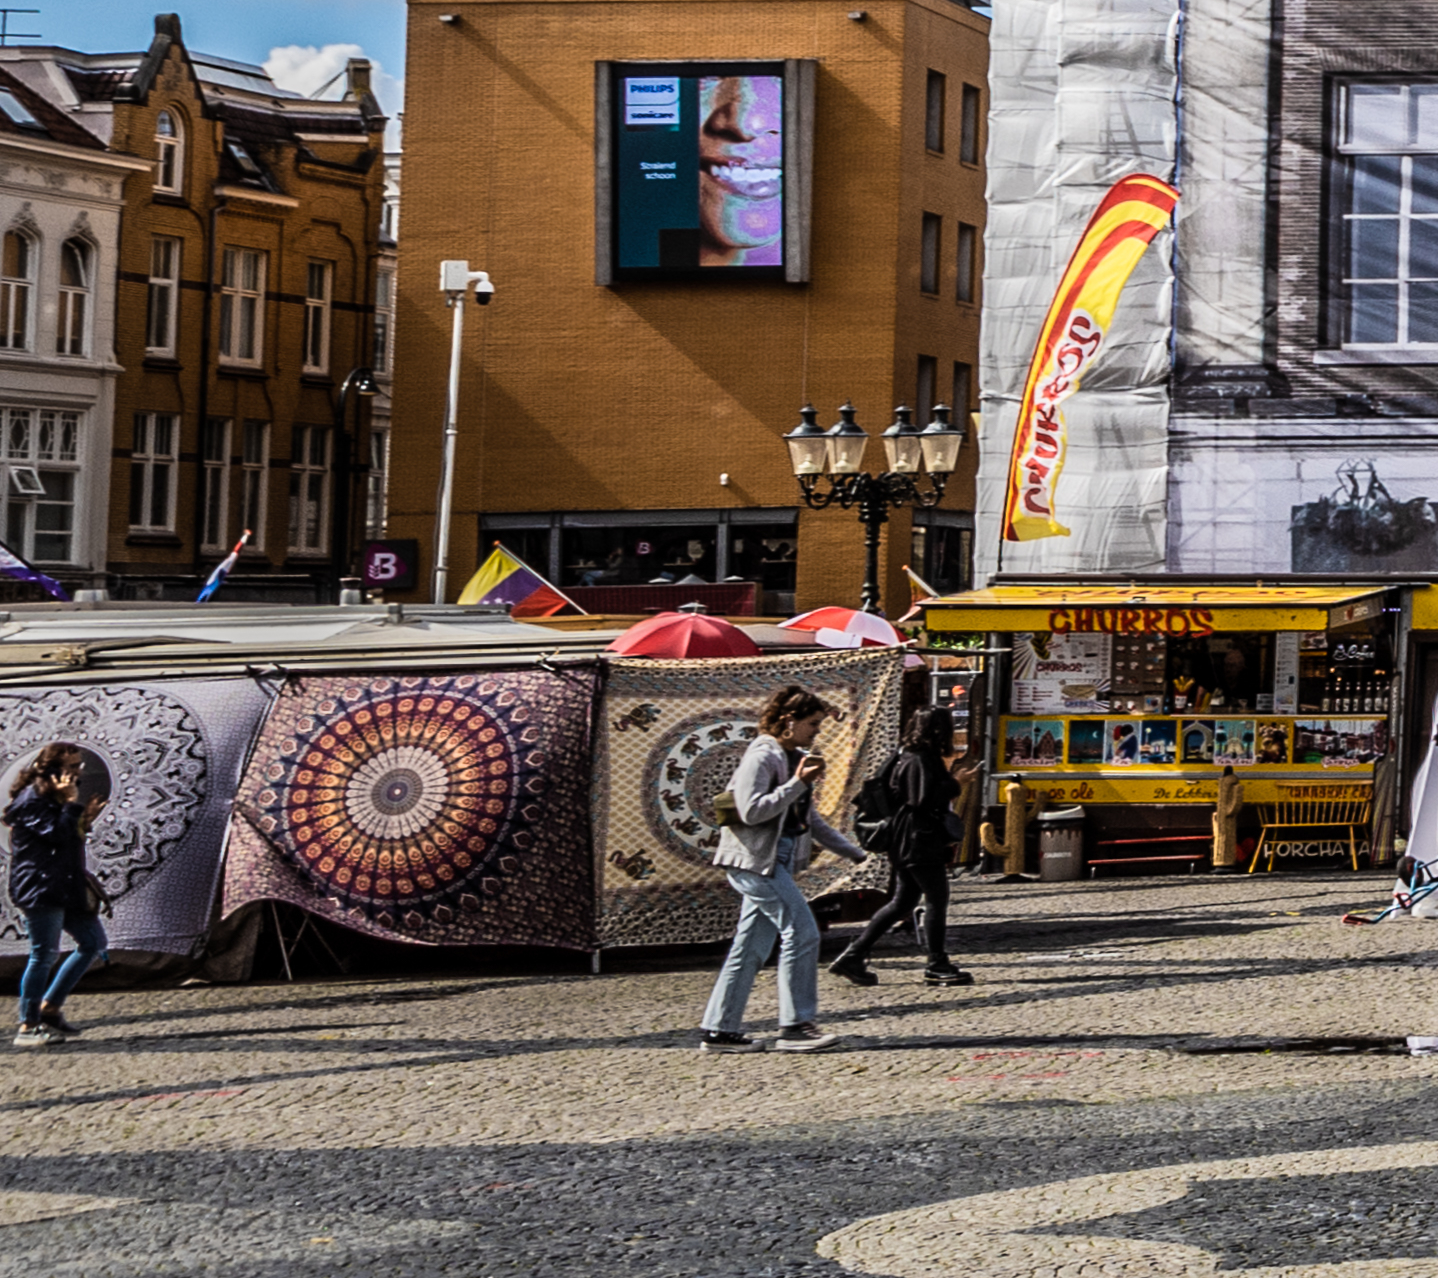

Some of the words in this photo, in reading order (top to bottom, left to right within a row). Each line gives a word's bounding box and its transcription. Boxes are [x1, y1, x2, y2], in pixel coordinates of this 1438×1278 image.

[630, 84, 674, 93] PHILIPS
[630, 110, 675, 119] sonicare
[645, 172, 677, 180] schoon
[1049, 608, 1213, 638] CHURROS
